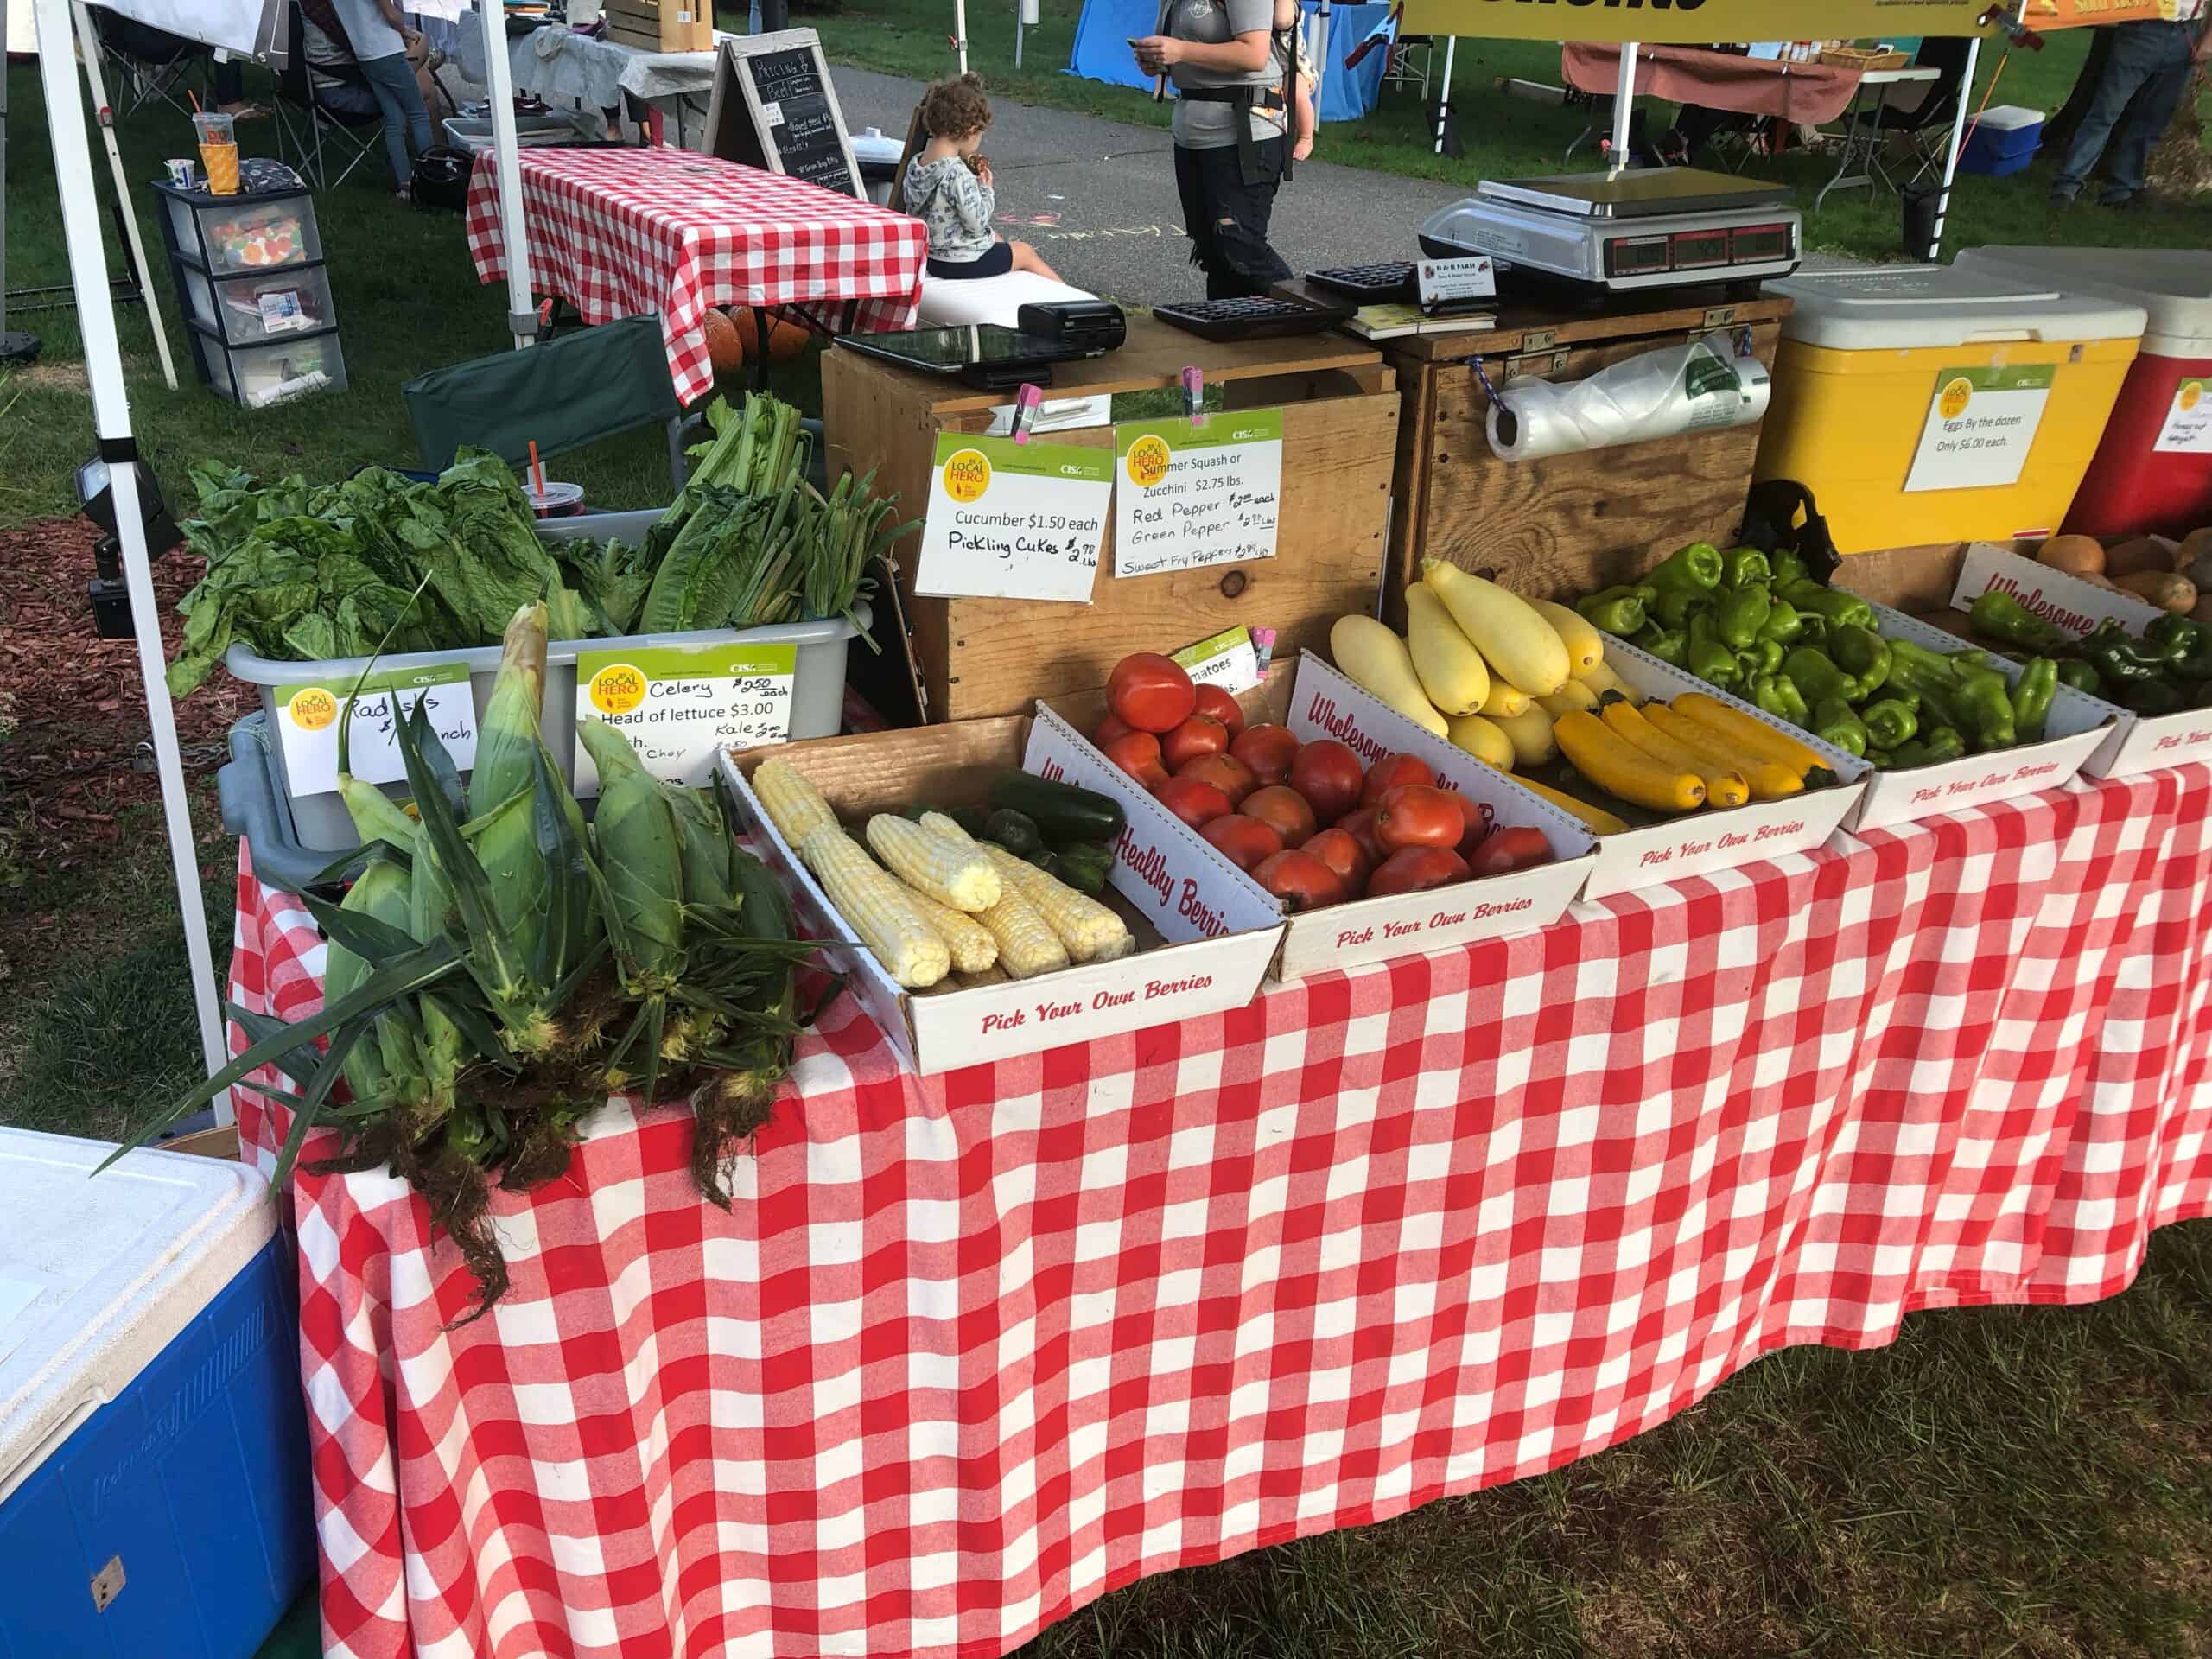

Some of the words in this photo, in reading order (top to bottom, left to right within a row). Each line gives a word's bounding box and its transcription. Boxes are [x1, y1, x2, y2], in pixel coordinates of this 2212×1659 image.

[1943, 420, 1963, 433] Eggs
[1966, 418, 1977, 431] By
[1979, 416, 1993, 428] the
[1995, 415, 2022, 427] dozen
[1133, 448, 1163, 459] LOCAL
[1936, 441, 1957, 452] Only
[952, 461, 983, 474] LOCAL
[1133, 455, 1164, 468] HERO
[1143, 461, 1188, 475] Summer
[1191, 454, 1227, 472] Squash
[1230, 454, 1242, 464] or
[950, 469, 984, 483] HERO
[1143, 481, 1187, 499] Zucchini
[1195, 477, 1224, 493] $2.75
[1227, 475, 1244, 487] lbs.
[955, 511, 1025, 528] Cucumber
[1028, 513, 1065, 530] $1.50
[1068, 518, 1098, 531] each
[1133, 507, 1163, 524] Red
[1172, 502, 1220, 518] Pepper
[1132, 531, 1176, 545] Green
[1183, 520, 1230, 539] Pepper
[1122, 556, 1167, 575] Sweet
[1171, 556, 1189, 568] Fry
[1190, 658, 1232, 682] matoes
[598, 676, 639, 687] LOCAL
[598, 684, 639, 696] HERO
[650, 681, 713, 698] Celery
[760, 686, 788, 697] each
[296, 697, 328, 708] LOCAL
[296, 703, 331, 715] HERO
[349, 697, 440, 719] Radss
[602, 710, 644, 726] Head
[649, 709, 666, 722] of
[671, 704, 726, 721] lettuce
[730, 702, 774, 718] $3.00
[715, 720, 753, 736] Kale
[1911, 785, 1942, 804] Pick
[1947, 780, 1977, 795] Your
[1980, 773, 2010, 788] Own
[2013, 761, 2059, 780] Berries
[1639, 847, 1672, 868] Pick
[1680, 841, 1712, 858] Your
[1718, 832, 1749, 849] Own
[1753, 820, 1804, 842] Berries
[1114, 823, 1175, 907] Healthy
[1178, 878, 1230, 938] Berri
[1337, 926, 1374, 948] Pick
[1382, 920, 1422, 938] Your
[1429, 912, 1467, 929] Own
[1473, 897, 1533, 920] Berries
[982, 1008, 1027, 1034] Pick
[1035, 1001, 1083, 1021] Your
[1092, 990, 1135, 1010] Own
[1144, 974, 1213, 1000] Berries
